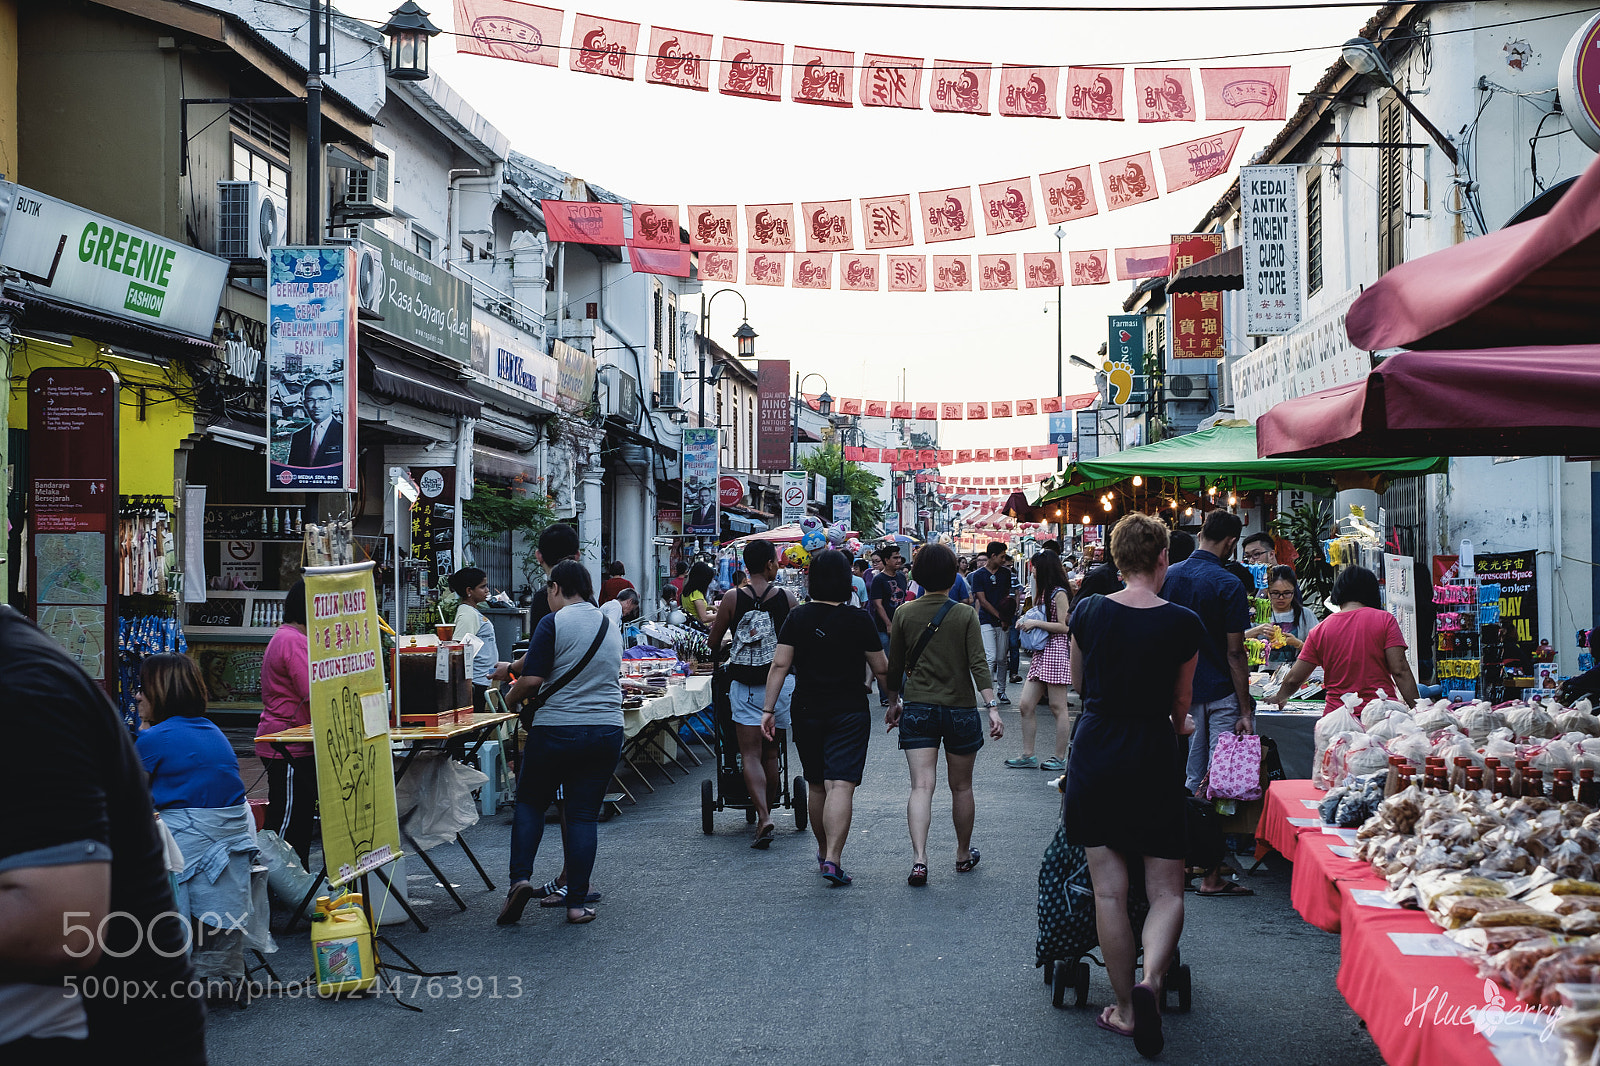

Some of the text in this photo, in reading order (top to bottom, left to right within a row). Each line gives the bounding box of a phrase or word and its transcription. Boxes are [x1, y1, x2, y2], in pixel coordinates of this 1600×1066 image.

[1251, 180, 1287, 195] KEDAI
[16, 196, 43, 218] BUTIK
[1252, 198, 1288, 212] ANTIK
[1252, 216, 1289, 240] ANCIENT
[78, 221, 176, 288] GREENIE
[1259, 243, 1285, 267] CURIO
[1258, 271, 1287, 295] STORE
[126, 287, 164, 312] FASHION
[388, 277, 412, 313] Rasa
[413, 291, 445, 331] Sayang
[295, 304, 321, 319] CEPAT
[280, 322, 339, 337] MELAKA MAJU
[1112, 319, 1138, 328] Farmasi
[294, 341, 315, 355] FASA
[761, 399, 787, 409] MING
[761, 409, 787, 419] STYLE
[34, 481, 70, 490] Bandaraya
[34, 495, 70, 503] Bersejarah
[1511, 570, 1533, 582] Space
[1501, 584, 1531, 594] onker
[314, 591, 367, 618] TILIK NASIB
[200, 614, 231, 625] CLOSE
